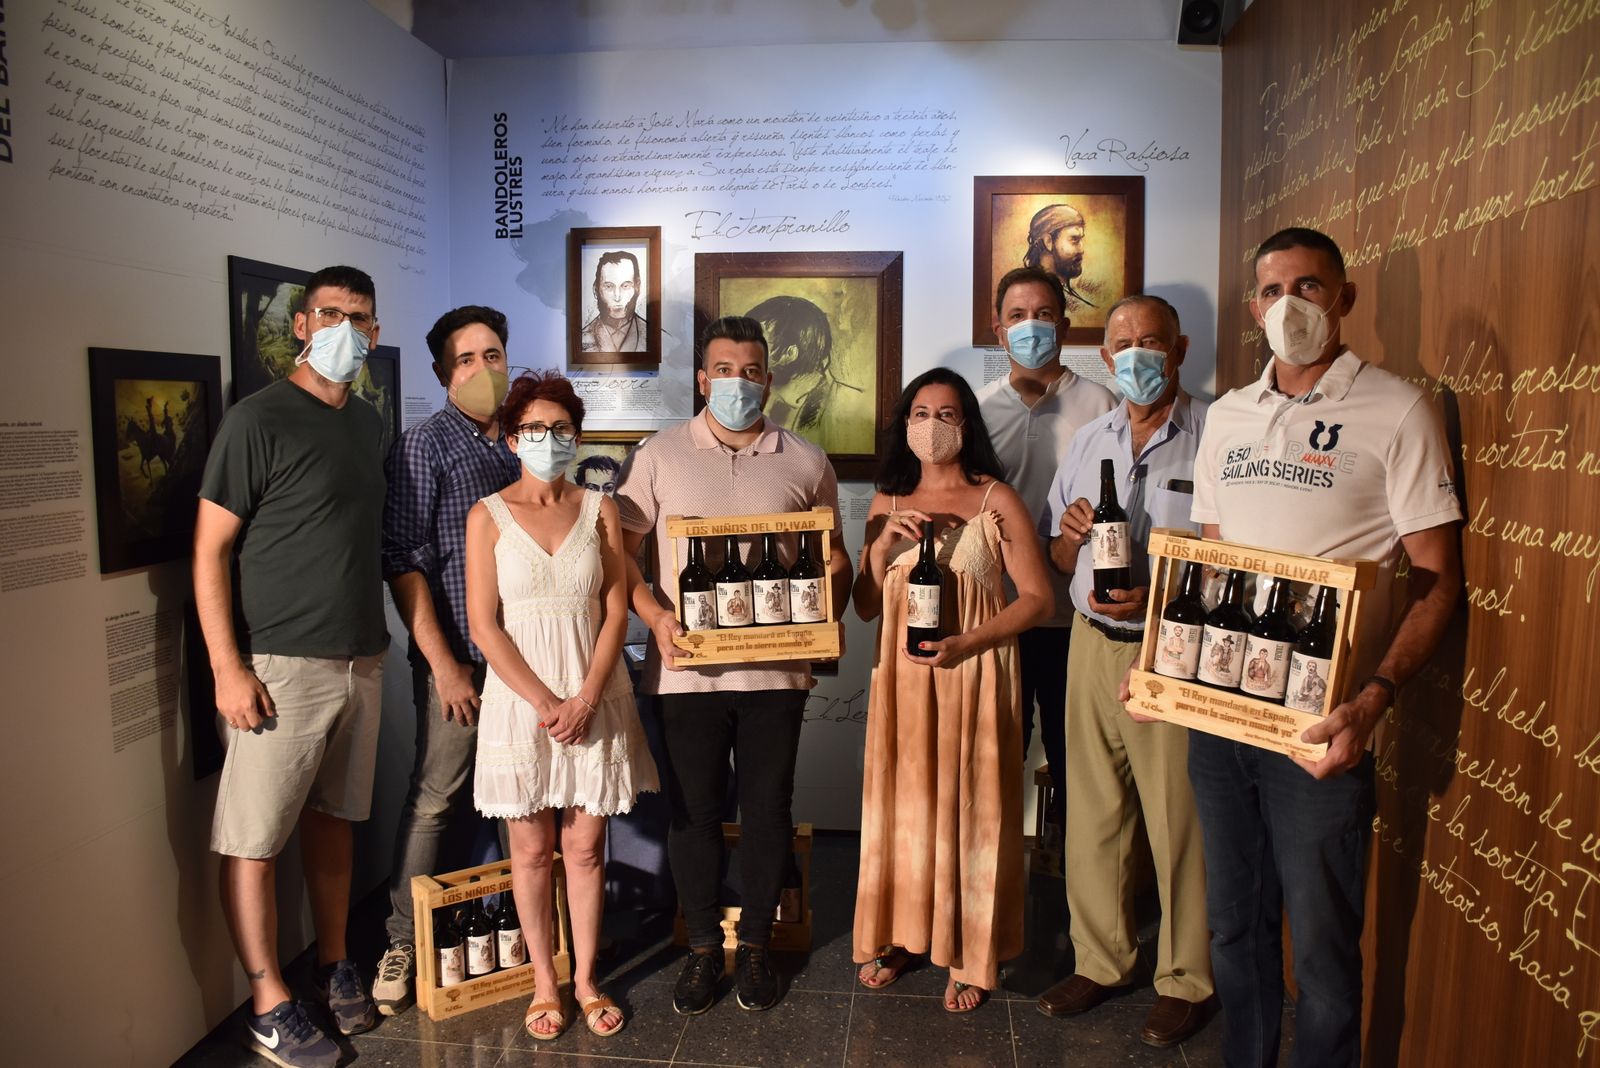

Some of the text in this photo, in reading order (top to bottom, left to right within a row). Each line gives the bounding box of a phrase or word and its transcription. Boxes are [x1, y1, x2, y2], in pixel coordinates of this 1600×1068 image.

[1456, 32, 1508, 98] Si
[617, 135, 630, 146] de
[834, 125, 874, 139] blancos
[880, 130, 906, 138] como
[824, 107, 881, 122] veinticinco
[541, 155, 568, 165] unos
[1060, 128, 1191, 173] Vaca Rabiosa
[494, 112, 509, 239] BANDOLEROS
[509, 156, 523, 239] ILUSTRES
[1385, 214, 1428, 271] pues
[1433, 184, 1453, 239] la
[1454, 191, 1517, 256] mayor
[1520, 121, 1600, 232] parte
[1388, 149, 1431, 220] bajen
[1450, 130, 1474, 168] se
[685, 208, 852, 241] El Tempranillo
[1475, 411, 1569, 470] cortesía
[1220, 459, 1270, 480] SAILING
[1271, 460, 1334, 489] SERIES
[685, 519, 817, 536] LOS NIÑOS DEL OLIVAR
[1469, 498, 1496, 537] de
[1501, 519, 1544, 547] una
[1164, 543, 1331, 584] LOS NIÑOS DEL OLIVAR
[835, 689, 868, 724] Le
[1192, 690, 1208, 703] Rey
[1497, 687, 1562, 759] dedo,
[1538, 792, 1573, 841] de
[1446, 794, 1472, 841] la
[1470, 828, 1568, 934] sortija.
[442, 880, 513, 904] LOS NIÑOS DE
[1420, 855, 1503, 954] ontrario,
[1508, 929, 1575, 1009] hacía
